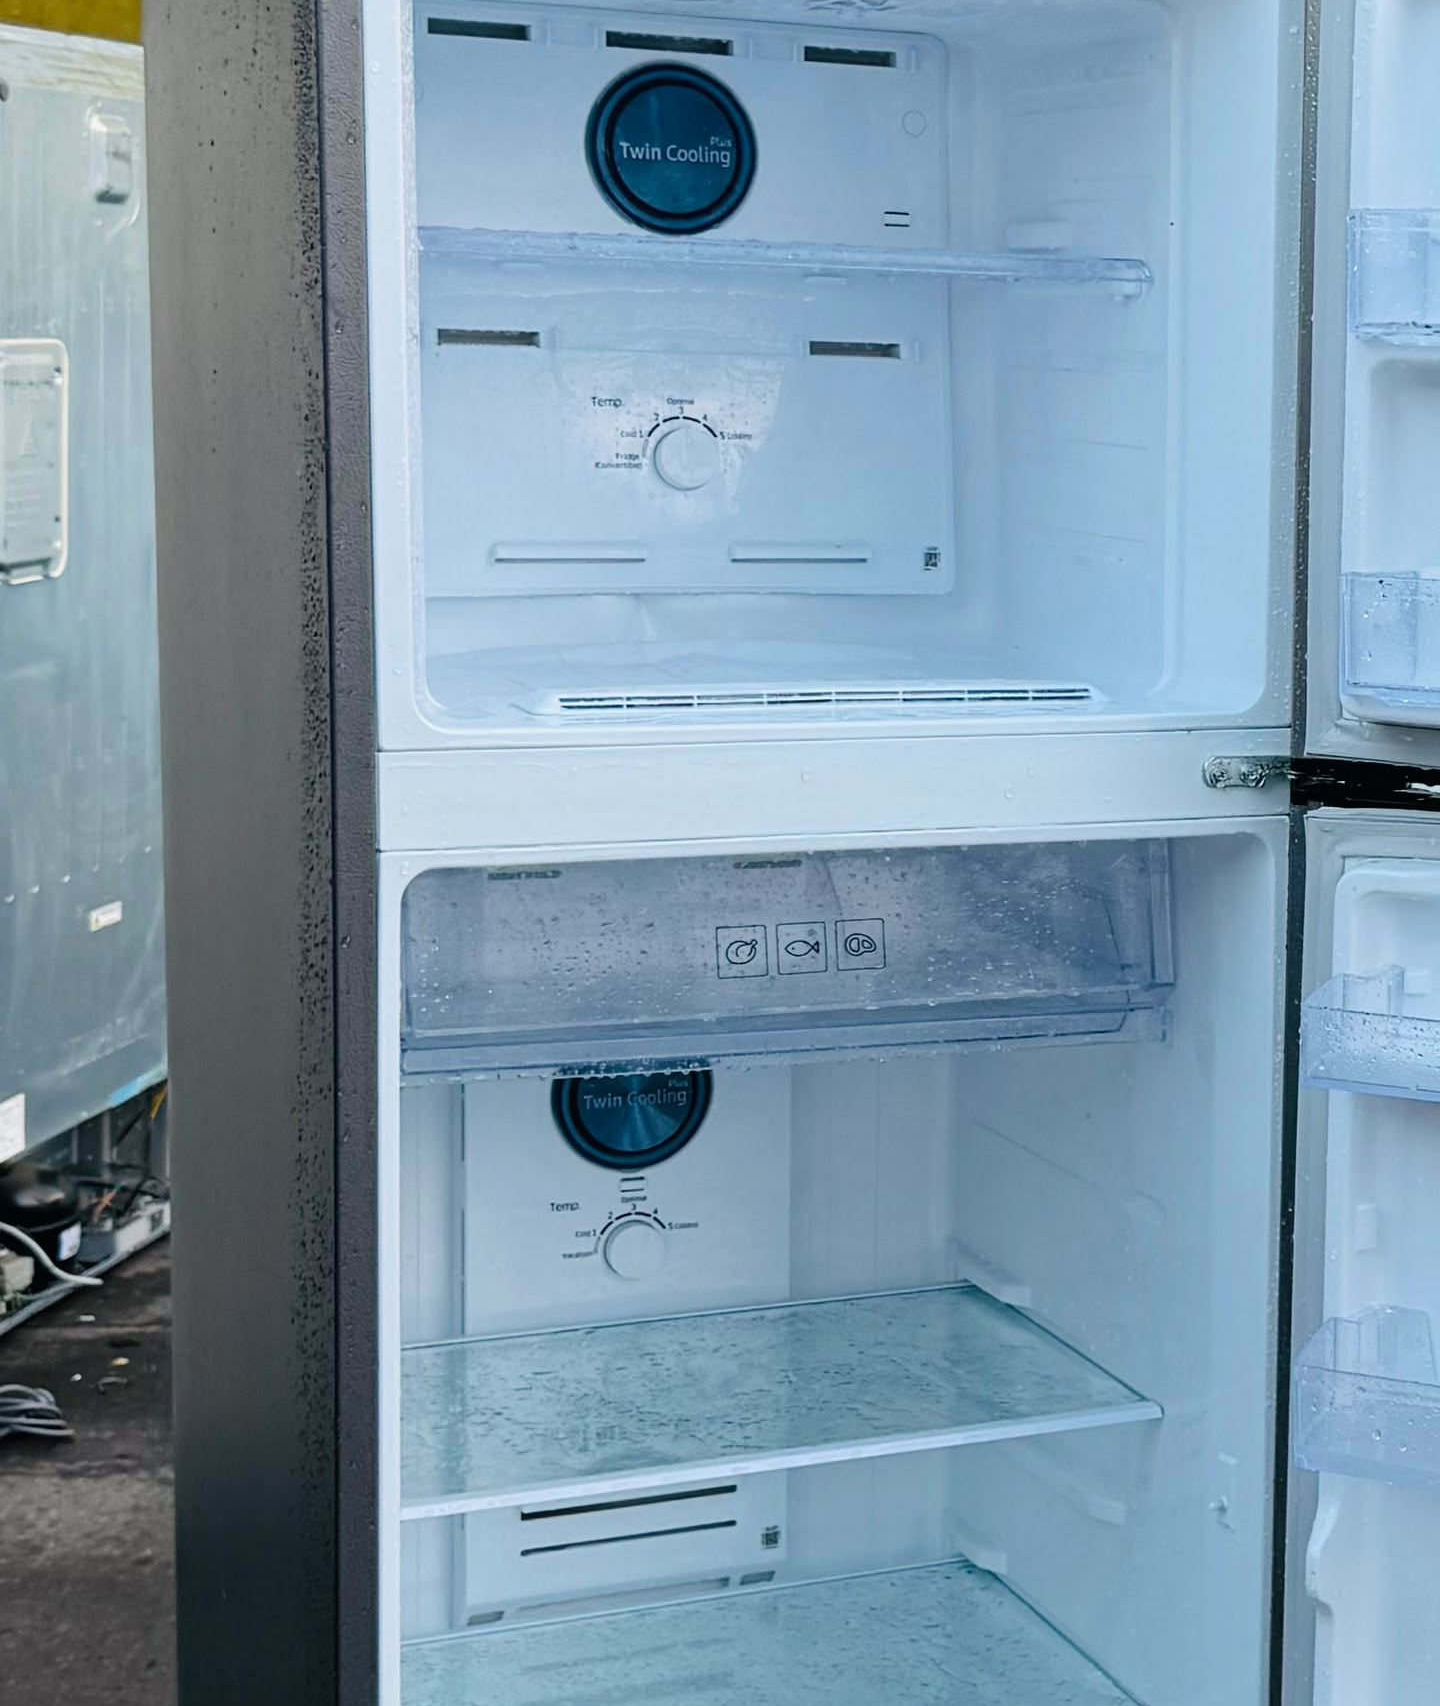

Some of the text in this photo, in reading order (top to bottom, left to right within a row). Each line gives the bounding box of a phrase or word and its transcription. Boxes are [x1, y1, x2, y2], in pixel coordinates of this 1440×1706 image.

[619, 141, 731, 168] Twin Cooling
[583, 1088, 687, 1110] Twin Cooling
